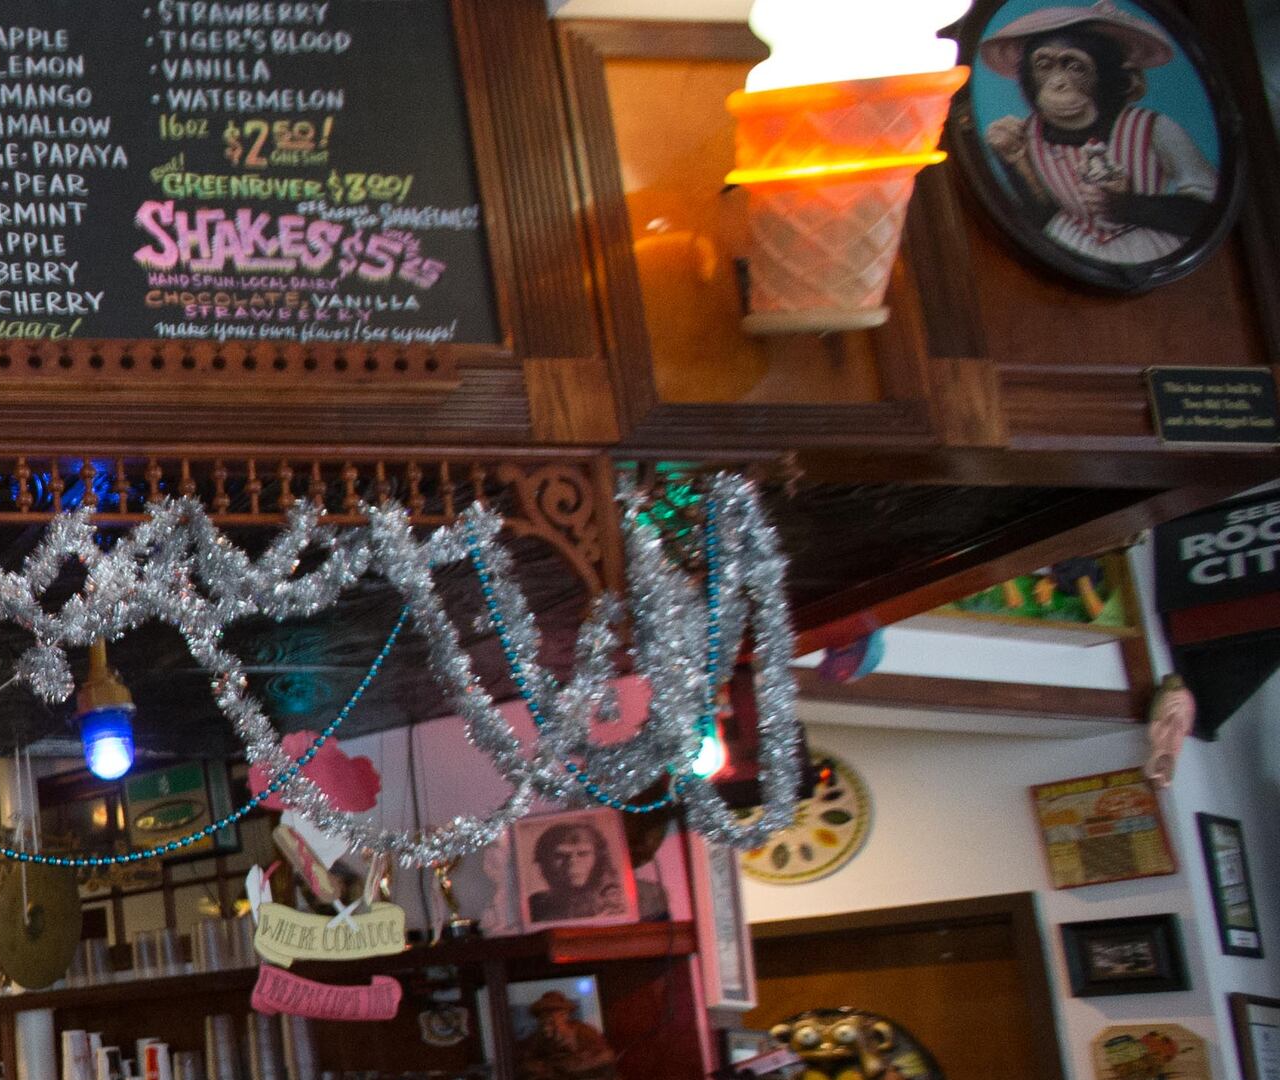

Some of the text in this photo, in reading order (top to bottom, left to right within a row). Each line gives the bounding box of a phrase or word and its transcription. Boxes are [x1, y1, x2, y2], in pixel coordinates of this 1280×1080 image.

[158, 0, 330, 25] STRAWBERRY
[158, 27, 352, 55] TIGER'S BLOOD
[161, 57, 273, 83] VANILLA
[166, 87, 345, 113] WATERMELON
[31, 140, 128, 170] PAPAYA
[13, 171, 89, 197] PEAR
[133, 199, 345, 274] SHAKES
[148, 271, 340, 293] HAND LOCAL DAIRY
[183, 304, 374, 324] STRAWBERRY
[311, 293, 421, 312] VANILLA
[153, 319, 391, 343] make your own see
[1225, 502, 1280, 525] SEE
[1179, 516, 1280, 560] ROC
[1189, 544, 1280, 585] CIT
[261, 914, 318, 951] WHERE
[368, 919, 401, 948] DOG
